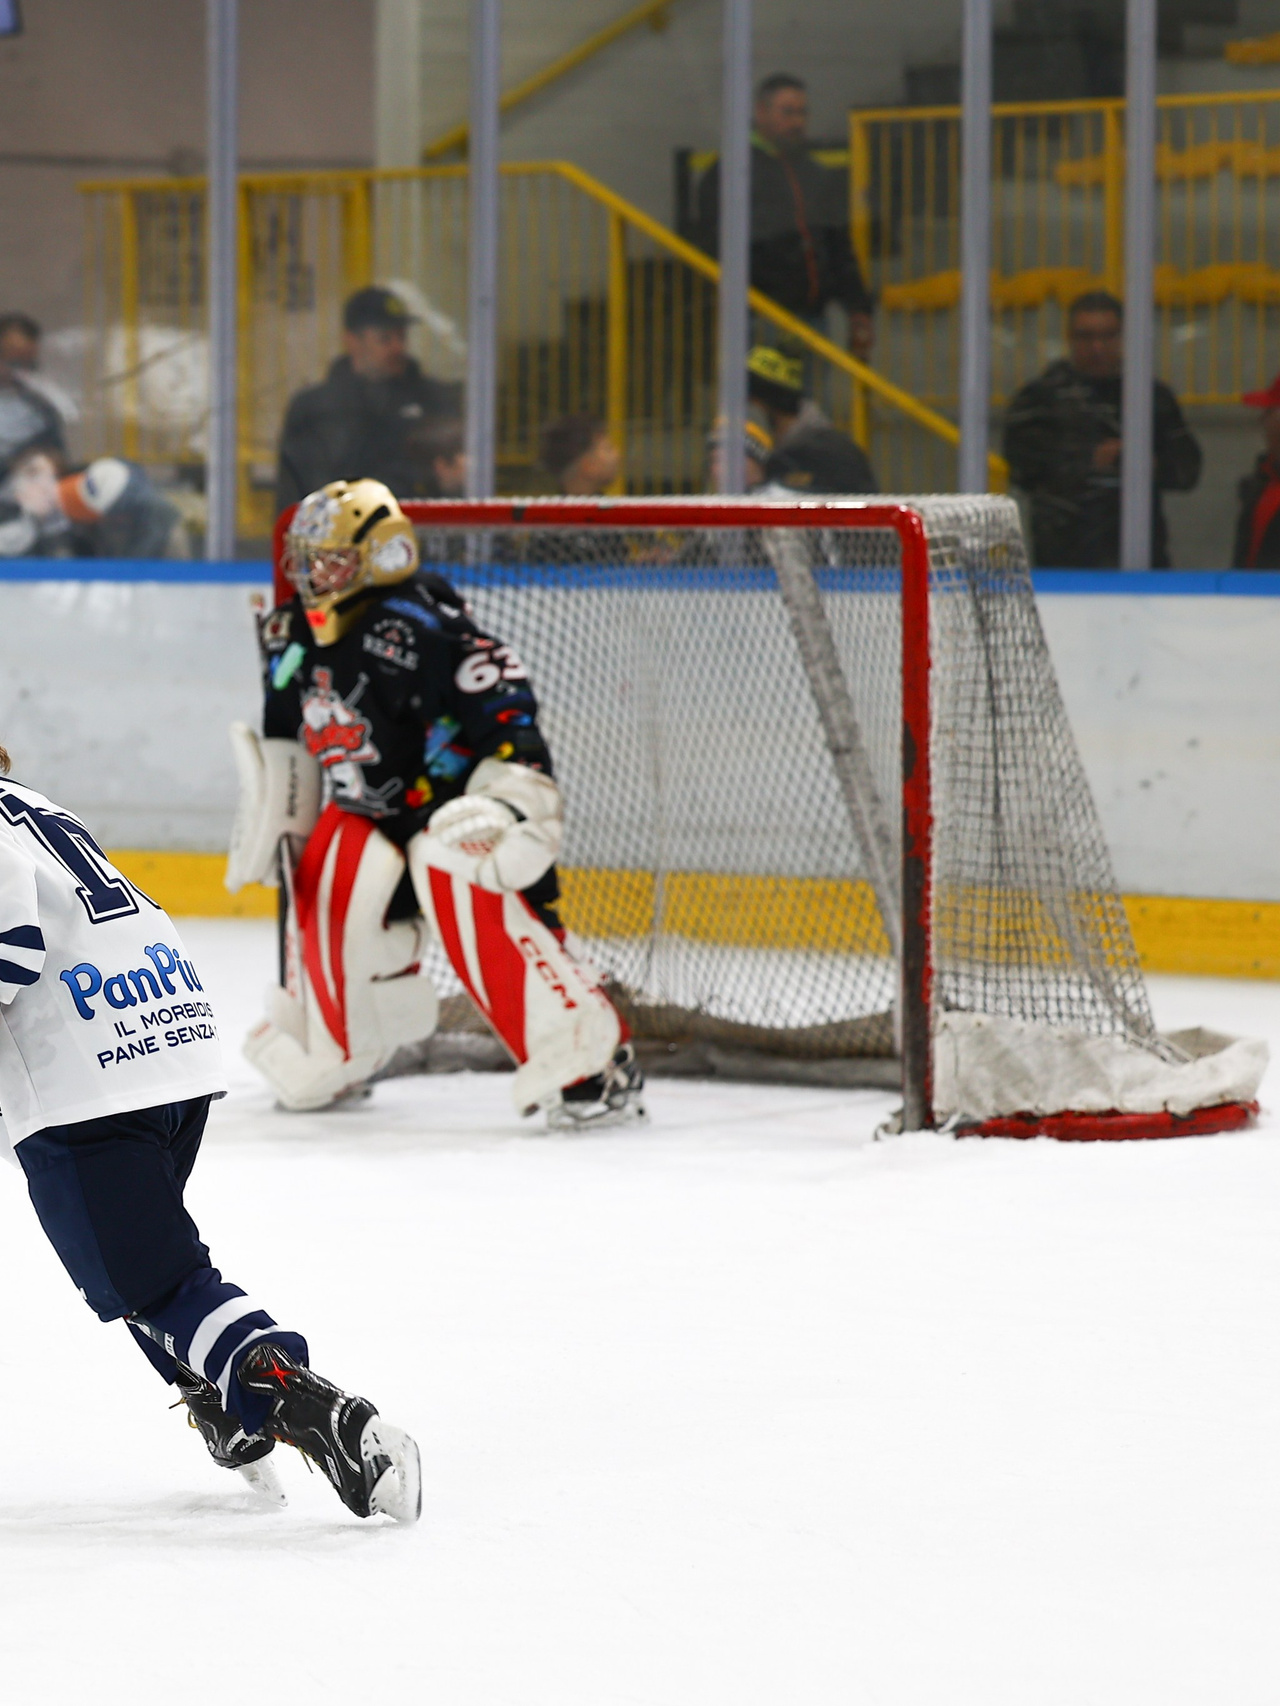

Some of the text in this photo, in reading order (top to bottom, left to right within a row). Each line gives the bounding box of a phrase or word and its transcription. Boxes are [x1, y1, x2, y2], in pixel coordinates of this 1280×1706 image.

[454, 646, 529, 694] 63
[96, 1036, 160, 1069] PANE
[164, 1023, 215, 1047] SENZA
[114, 1021, 137, 1038] IL
